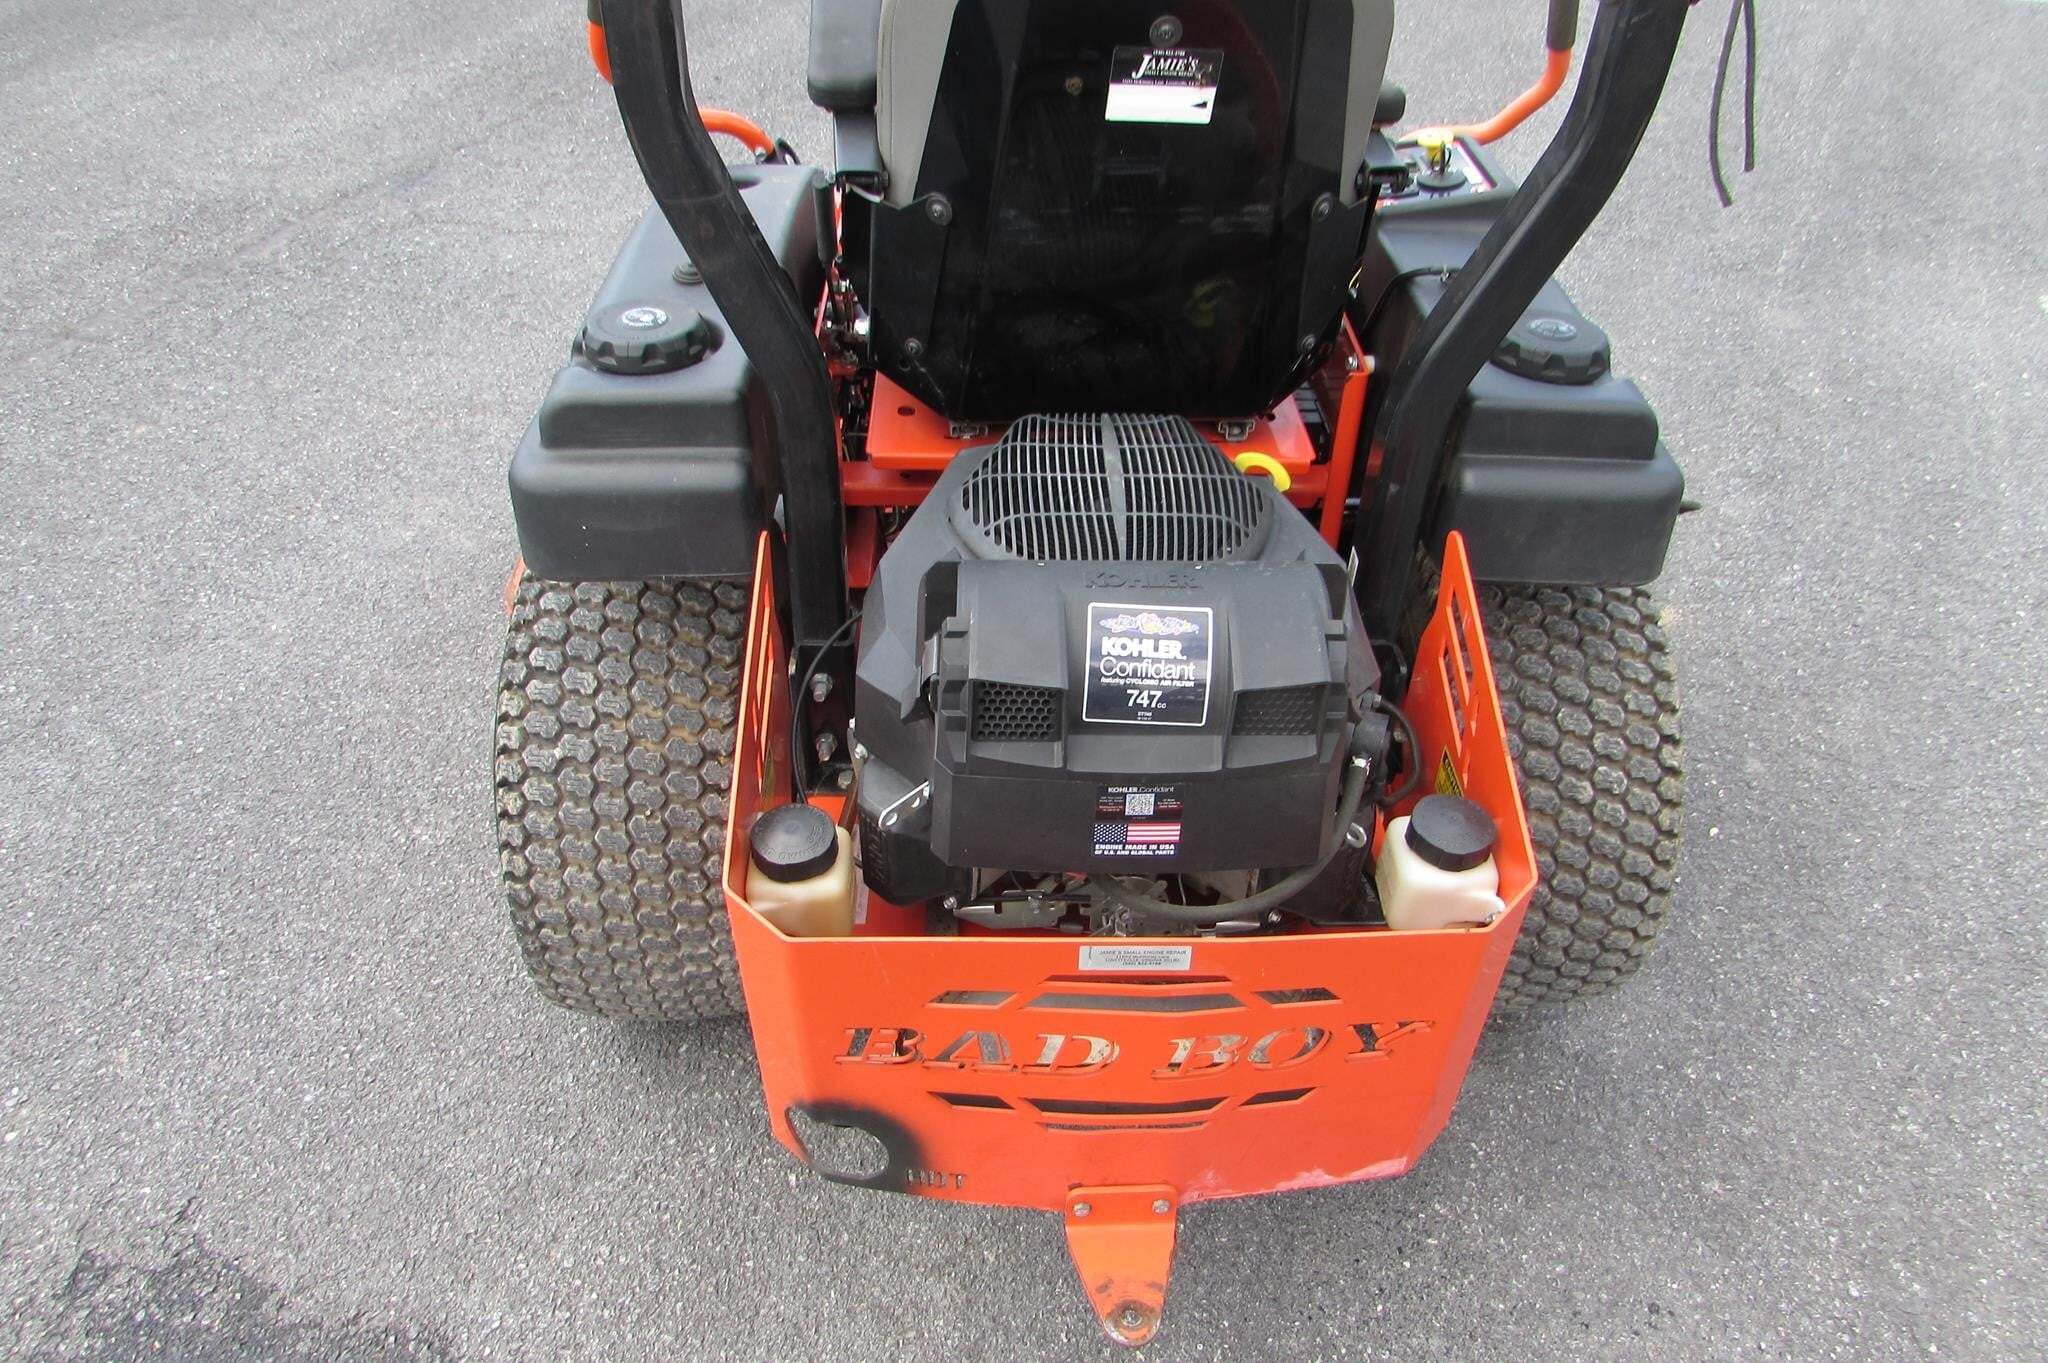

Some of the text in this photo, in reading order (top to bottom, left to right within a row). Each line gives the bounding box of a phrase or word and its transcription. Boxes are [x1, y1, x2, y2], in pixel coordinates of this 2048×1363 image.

[1132, 54, 1199, 79] JAMIE'S
[1100, 656, 1195, 680] Confidant
[1101, 677, 1125, 685] featuring
[1126, 678, 1159, 686] CYCLONIC
[1127, 689, 1162, 708] 747
[834, 1020, 1436, 1080] BAD BOY
